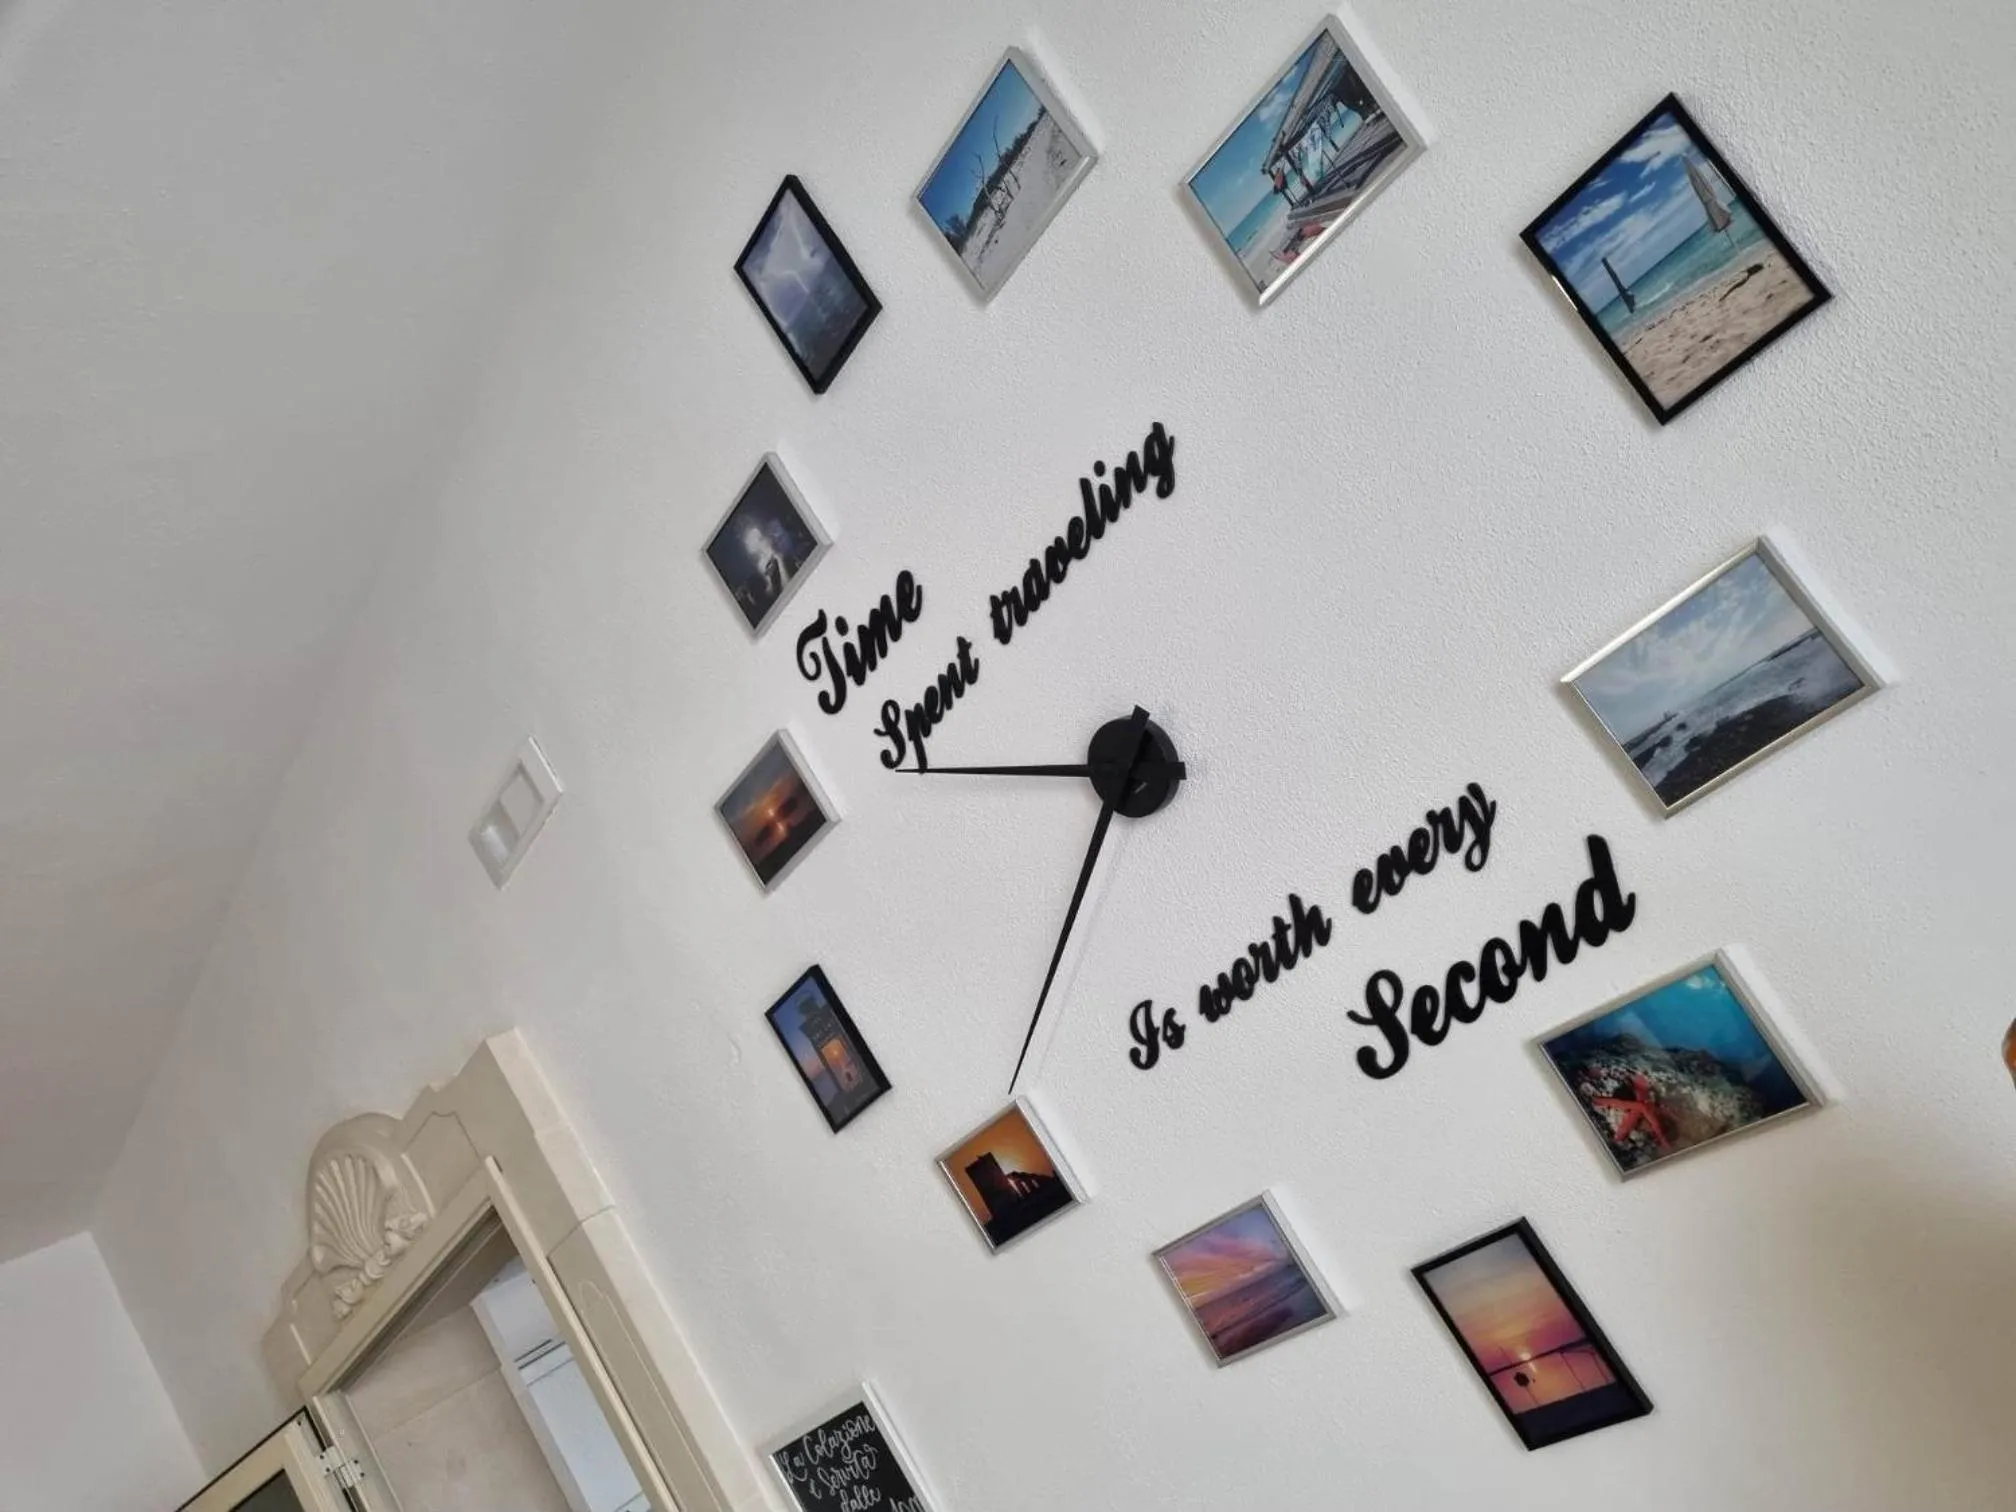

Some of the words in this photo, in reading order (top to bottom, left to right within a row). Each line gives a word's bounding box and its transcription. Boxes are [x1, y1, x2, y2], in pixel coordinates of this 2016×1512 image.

[796, 570, 923, 715] Time
[873, 636, 980, 773] Spent
[989, 421, 1175, 645] traveling
[1129, 999, 1187, 1070] Is
[1199, 893, 1332, 1023] worth
[1352, 782, 1497, 915] every
[1346, 834, 1636, 1080] Second
